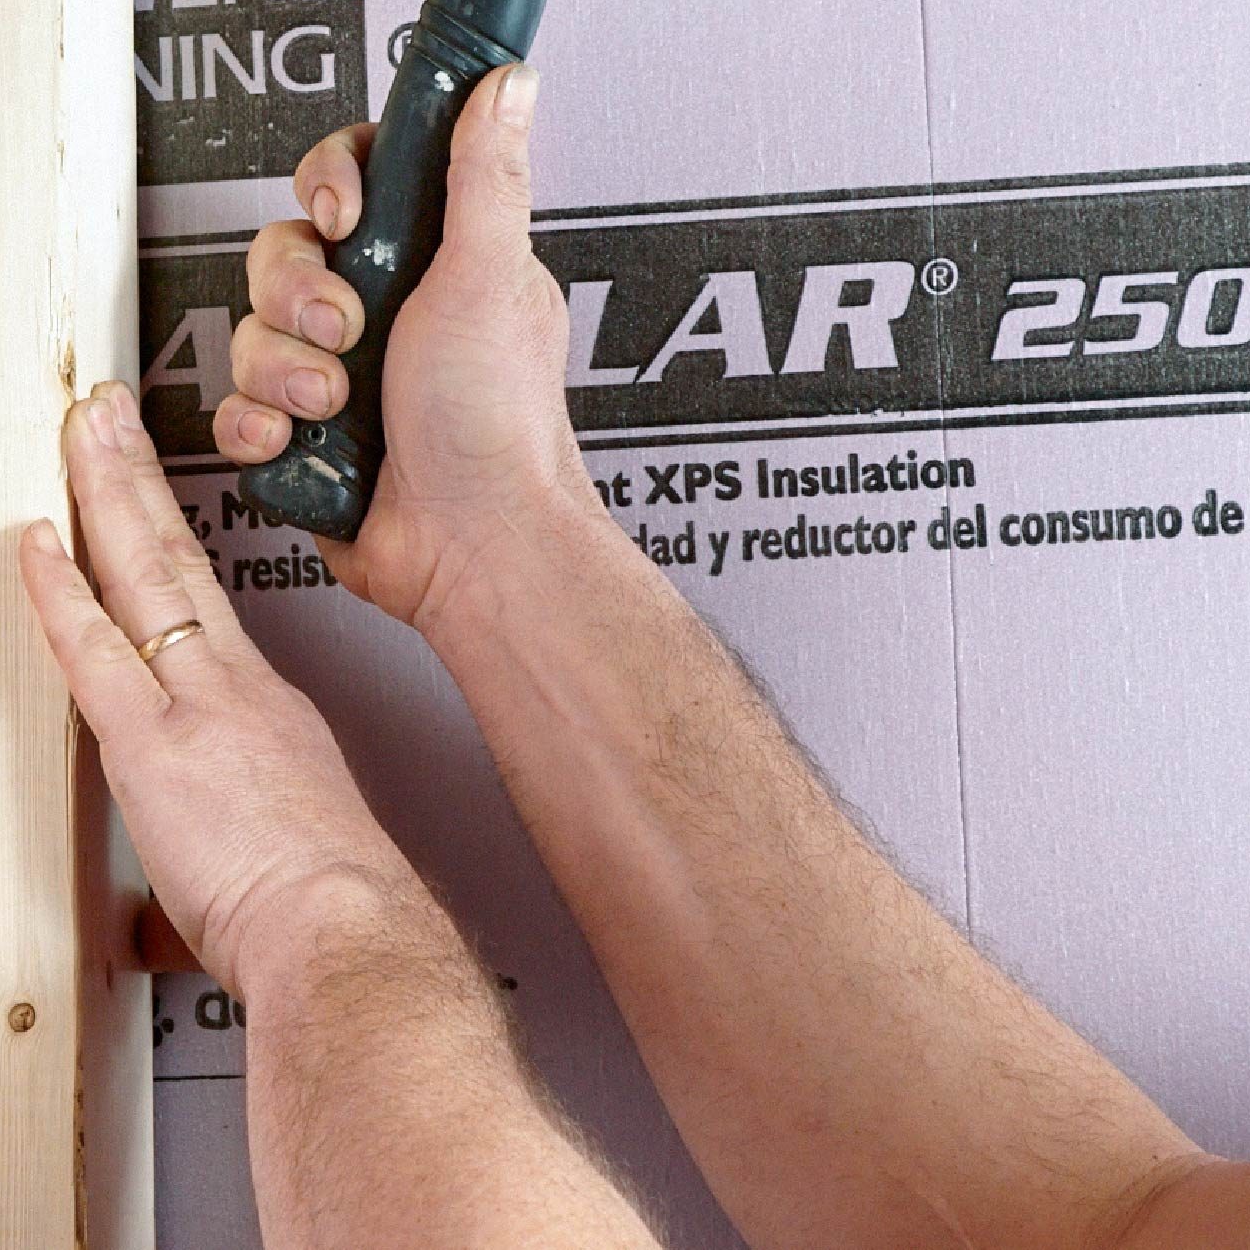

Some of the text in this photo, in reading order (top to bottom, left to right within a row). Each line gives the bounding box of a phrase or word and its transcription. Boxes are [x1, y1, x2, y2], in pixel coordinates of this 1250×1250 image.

[990, 267, 1250, 362] 250
[645, 459, 743, 506] XPS
[757, 449, 976, 499] Insulation
[232, 542, 338, 591] resist
[708, 530, 730, 577] y
[742, 513, 917, 561] reductor
[927, 503, 988, 551] del
[999, 504, 1183, 547] consumo
[1192, 488, 1246, 537] de
